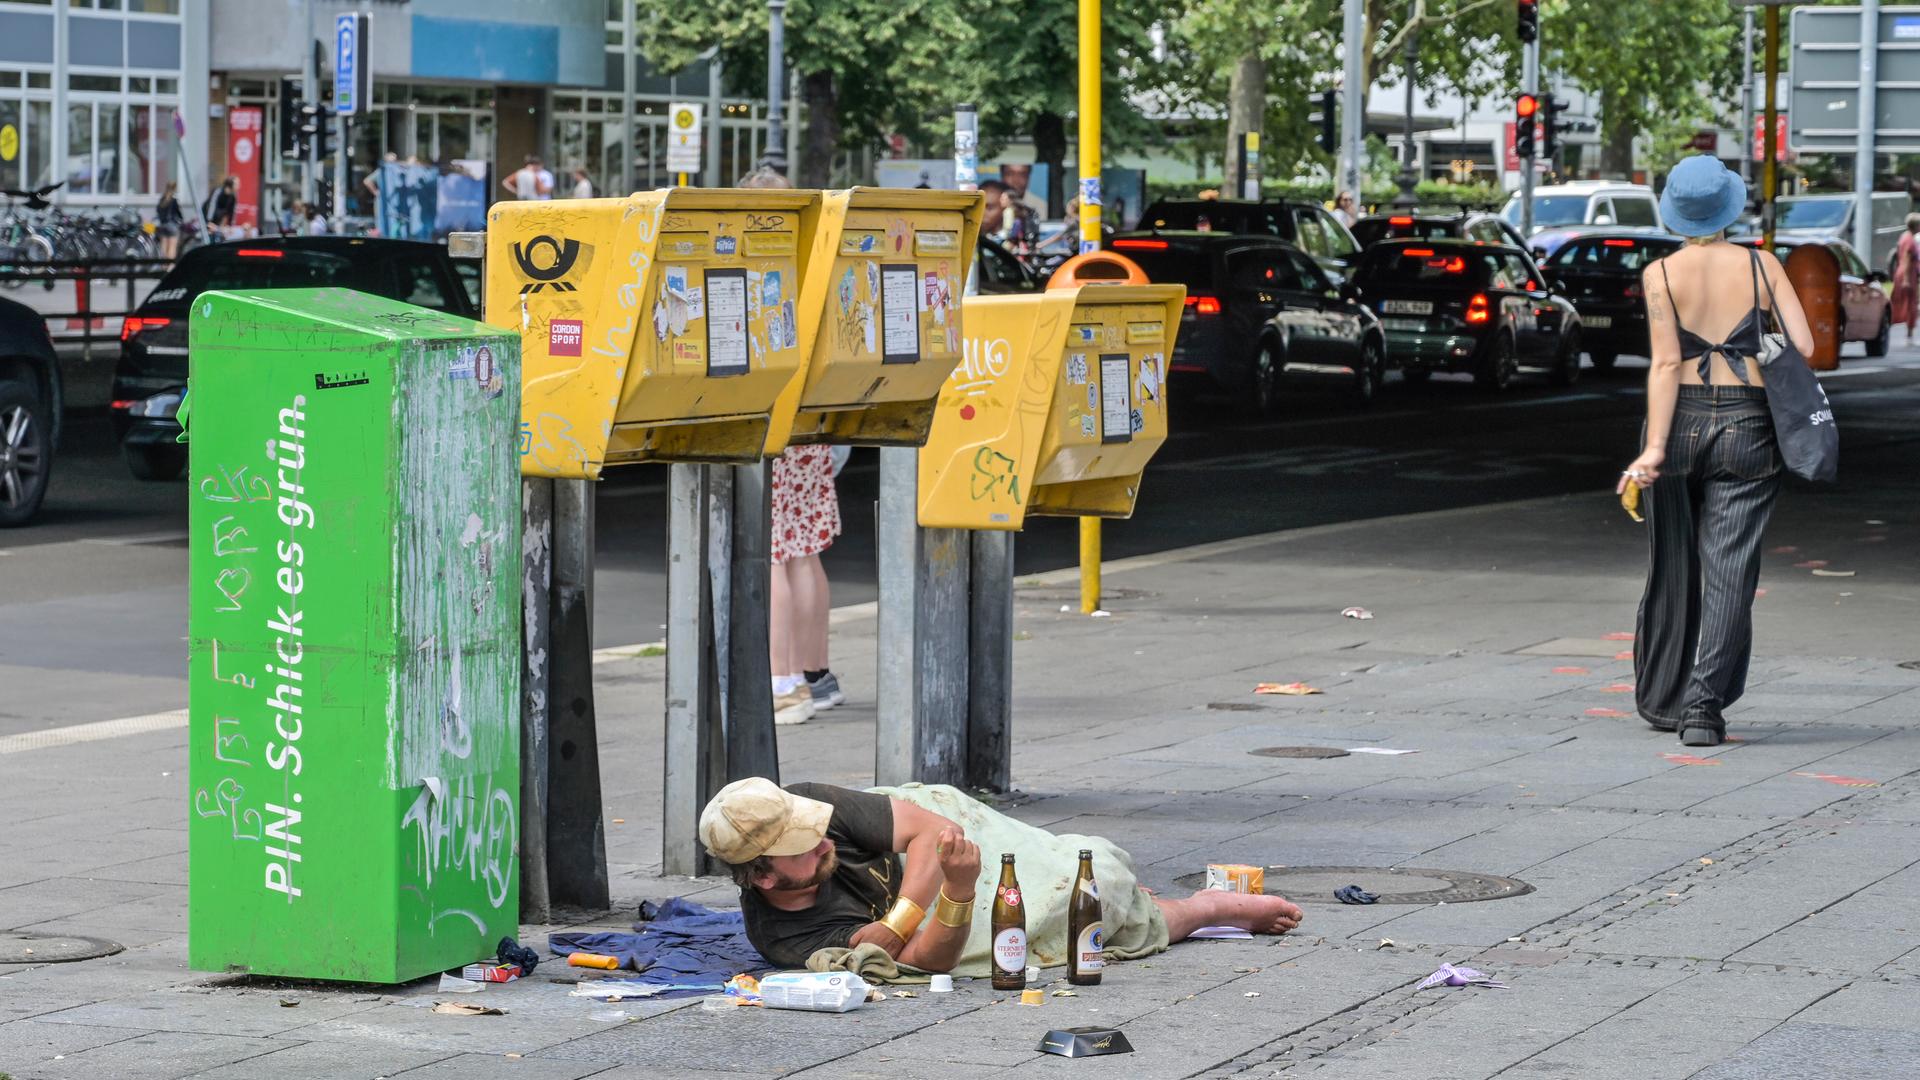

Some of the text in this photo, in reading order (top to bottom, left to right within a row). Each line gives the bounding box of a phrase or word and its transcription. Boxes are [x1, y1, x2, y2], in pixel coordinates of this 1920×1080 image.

[551, 335, 580, 345] SPORT
[552, 324, 581, 334] CORDON
[275, 540, 305, 596] es
[265, 605, 305, 777] Schick
[265, 793, 303, 898] PIN.
